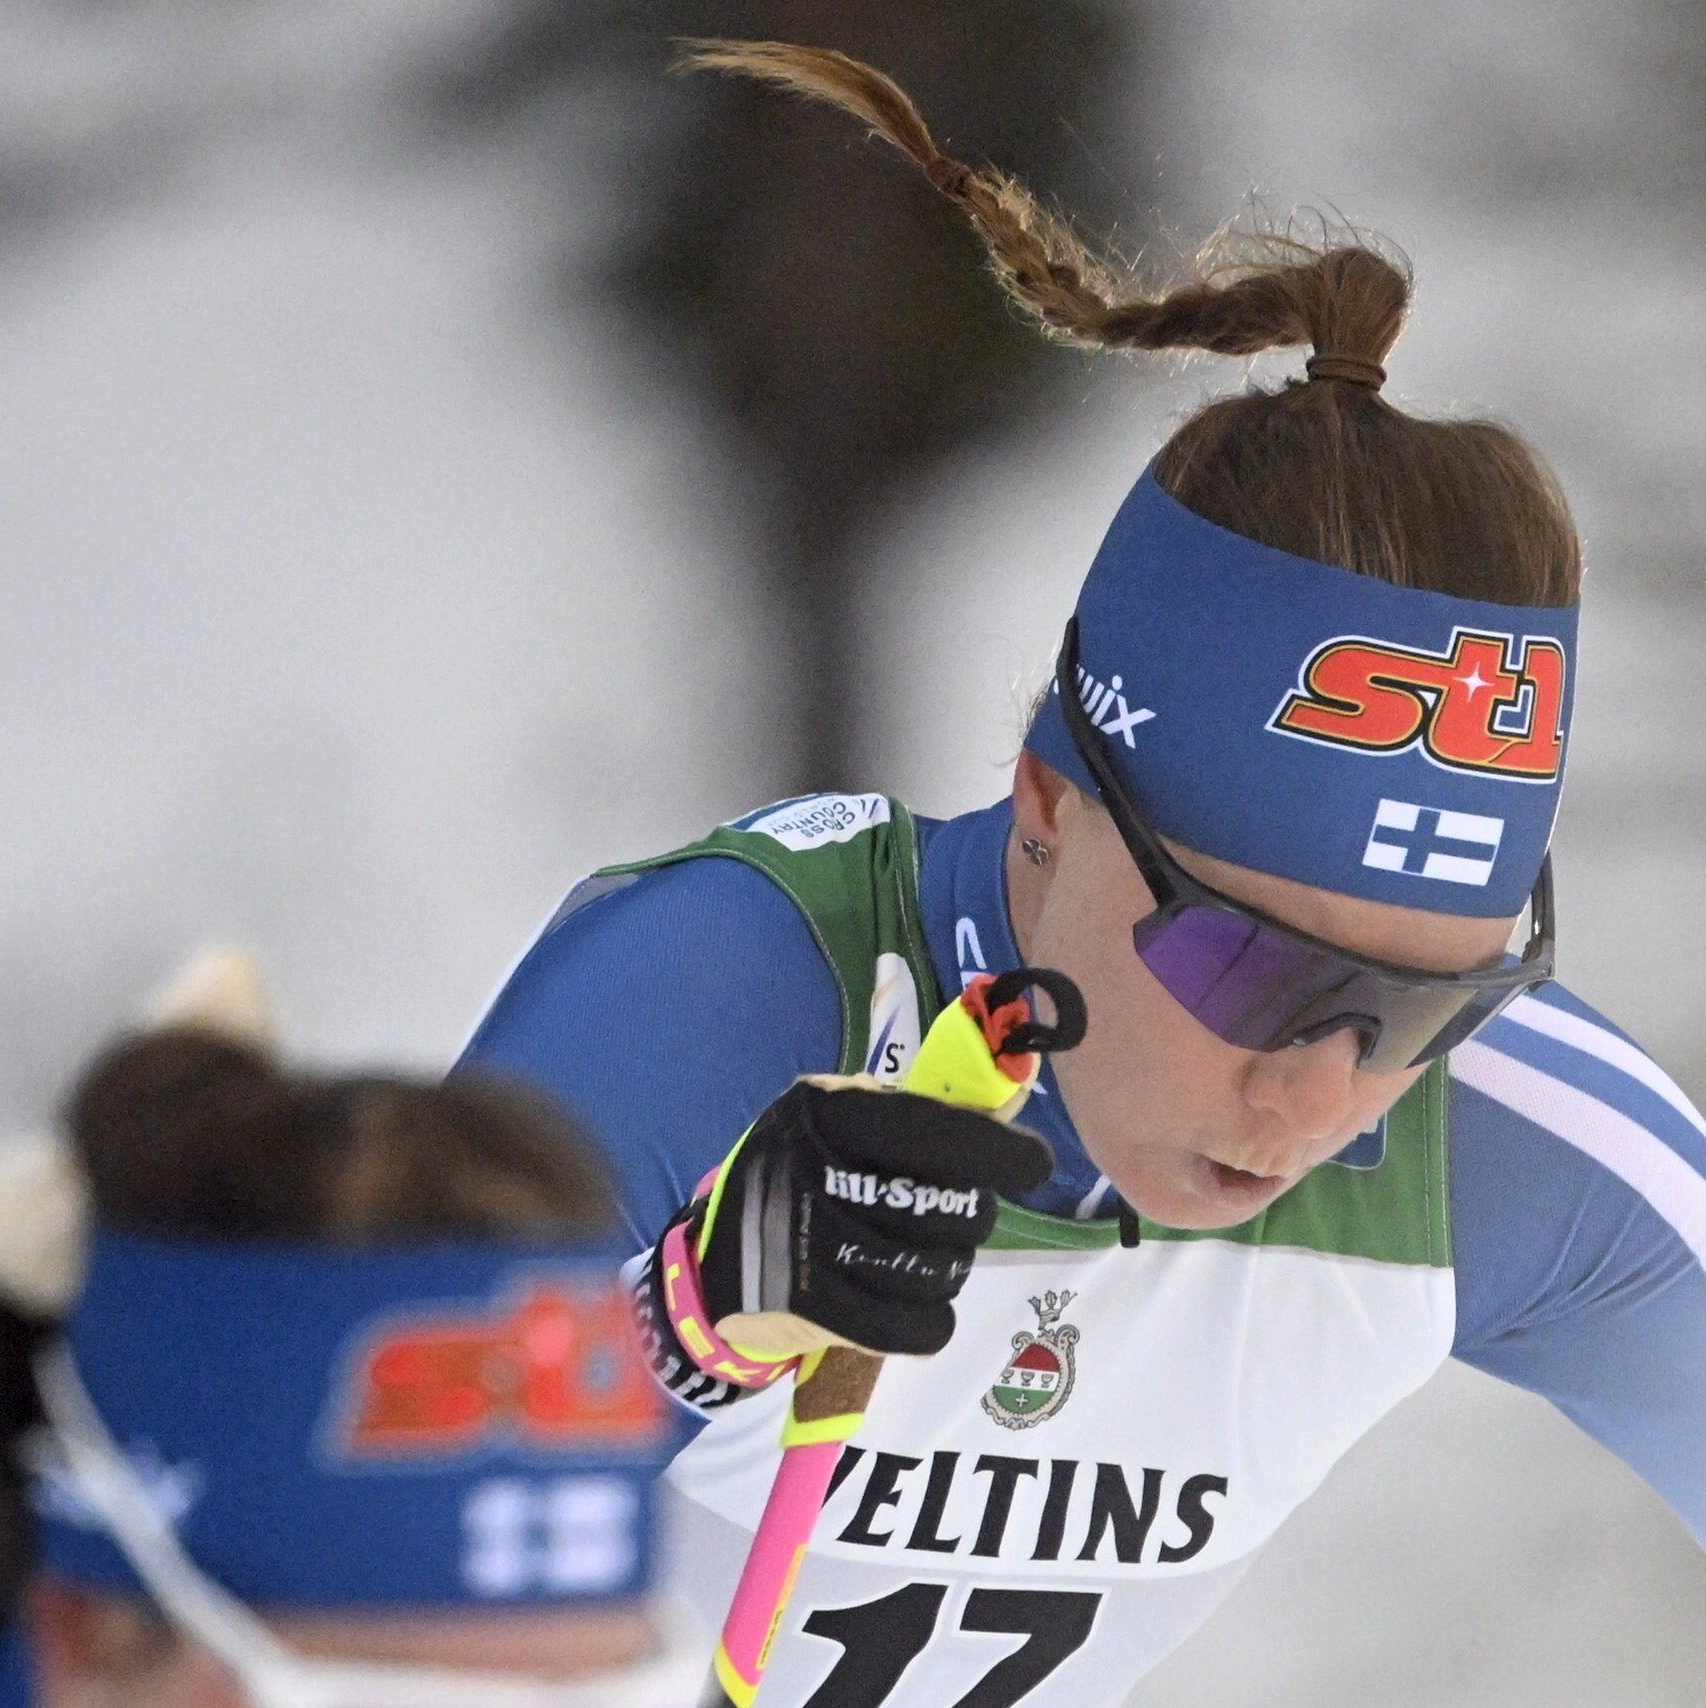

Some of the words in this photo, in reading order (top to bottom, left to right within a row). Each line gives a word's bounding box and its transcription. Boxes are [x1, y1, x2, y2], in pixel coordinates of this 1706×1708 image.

[1053, 664, 1157, 749] wix
[772, 802, 846, 834] COUNTRY
[801, 811, 855, 838] CROSS
